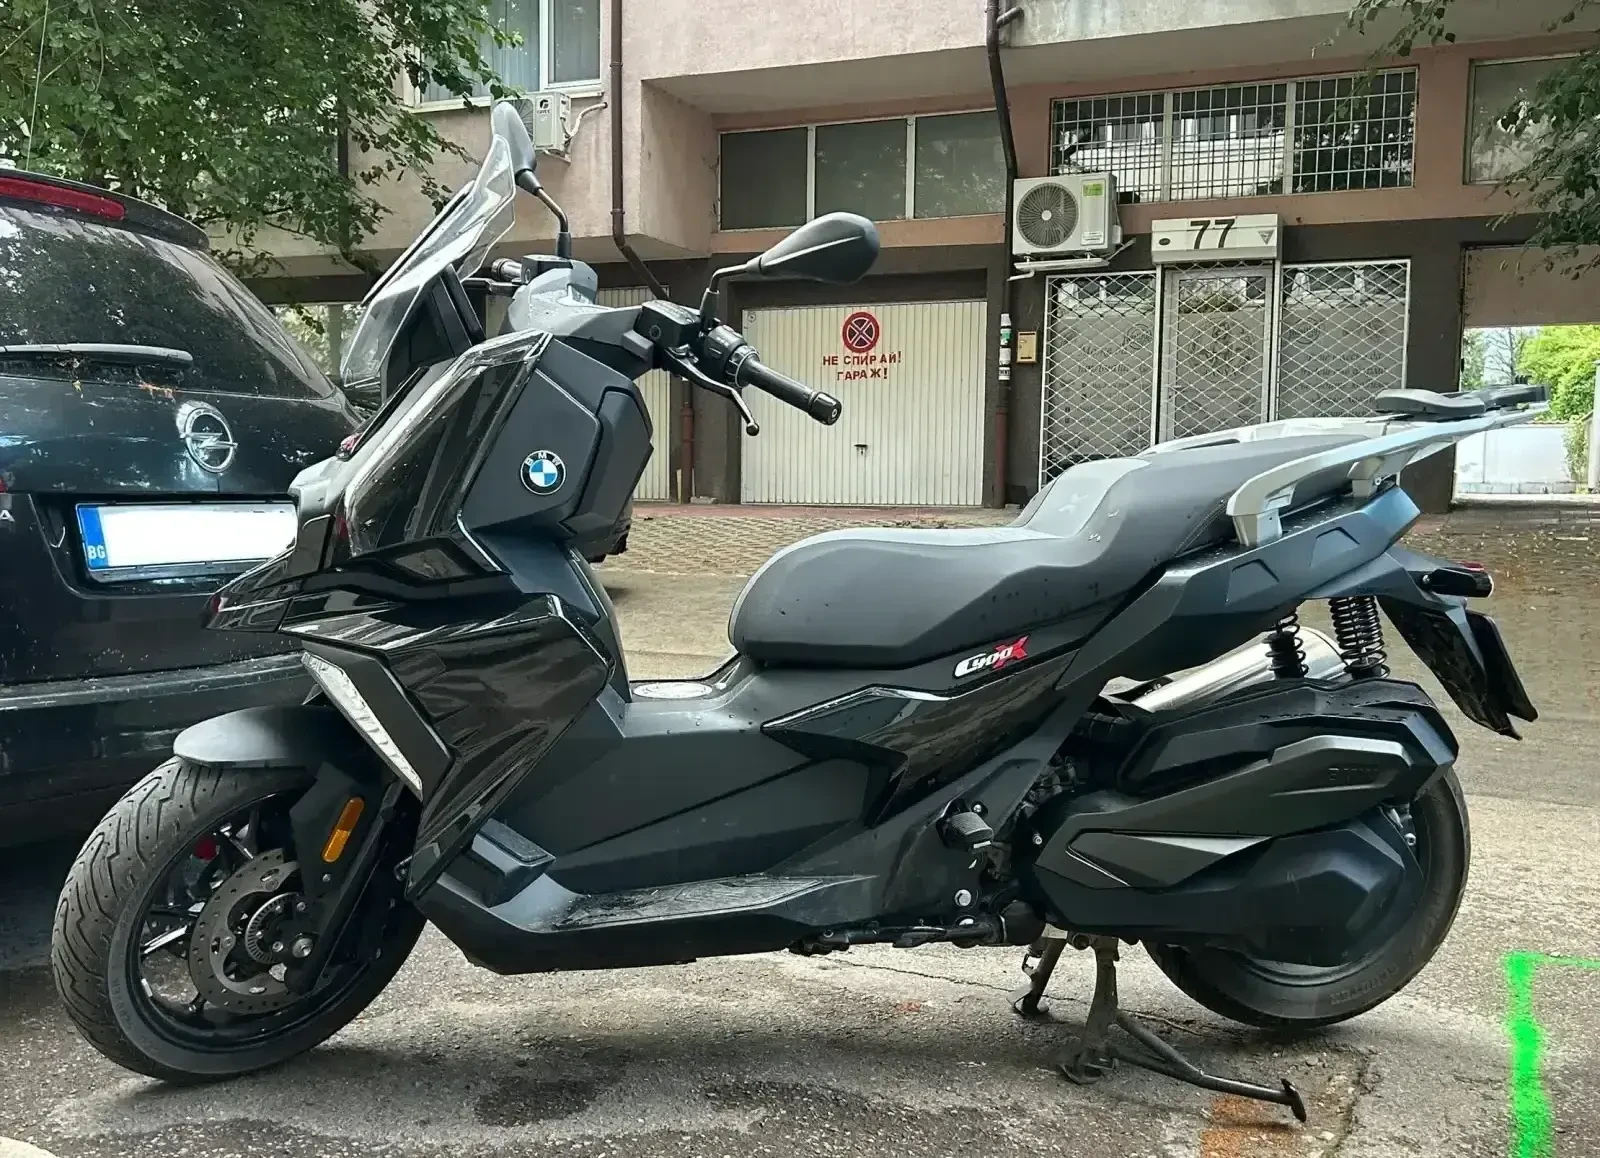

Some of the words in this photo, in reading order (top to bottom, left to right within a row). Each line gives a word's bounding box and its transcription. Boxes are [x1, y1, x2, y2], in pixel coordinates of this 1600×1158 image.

[1190, 218, 1235, 250] 77
[823, 356, 838, 365] НЕ
[525, 451, 561, 466] BMW
[87, 545, 106, 559] BG
